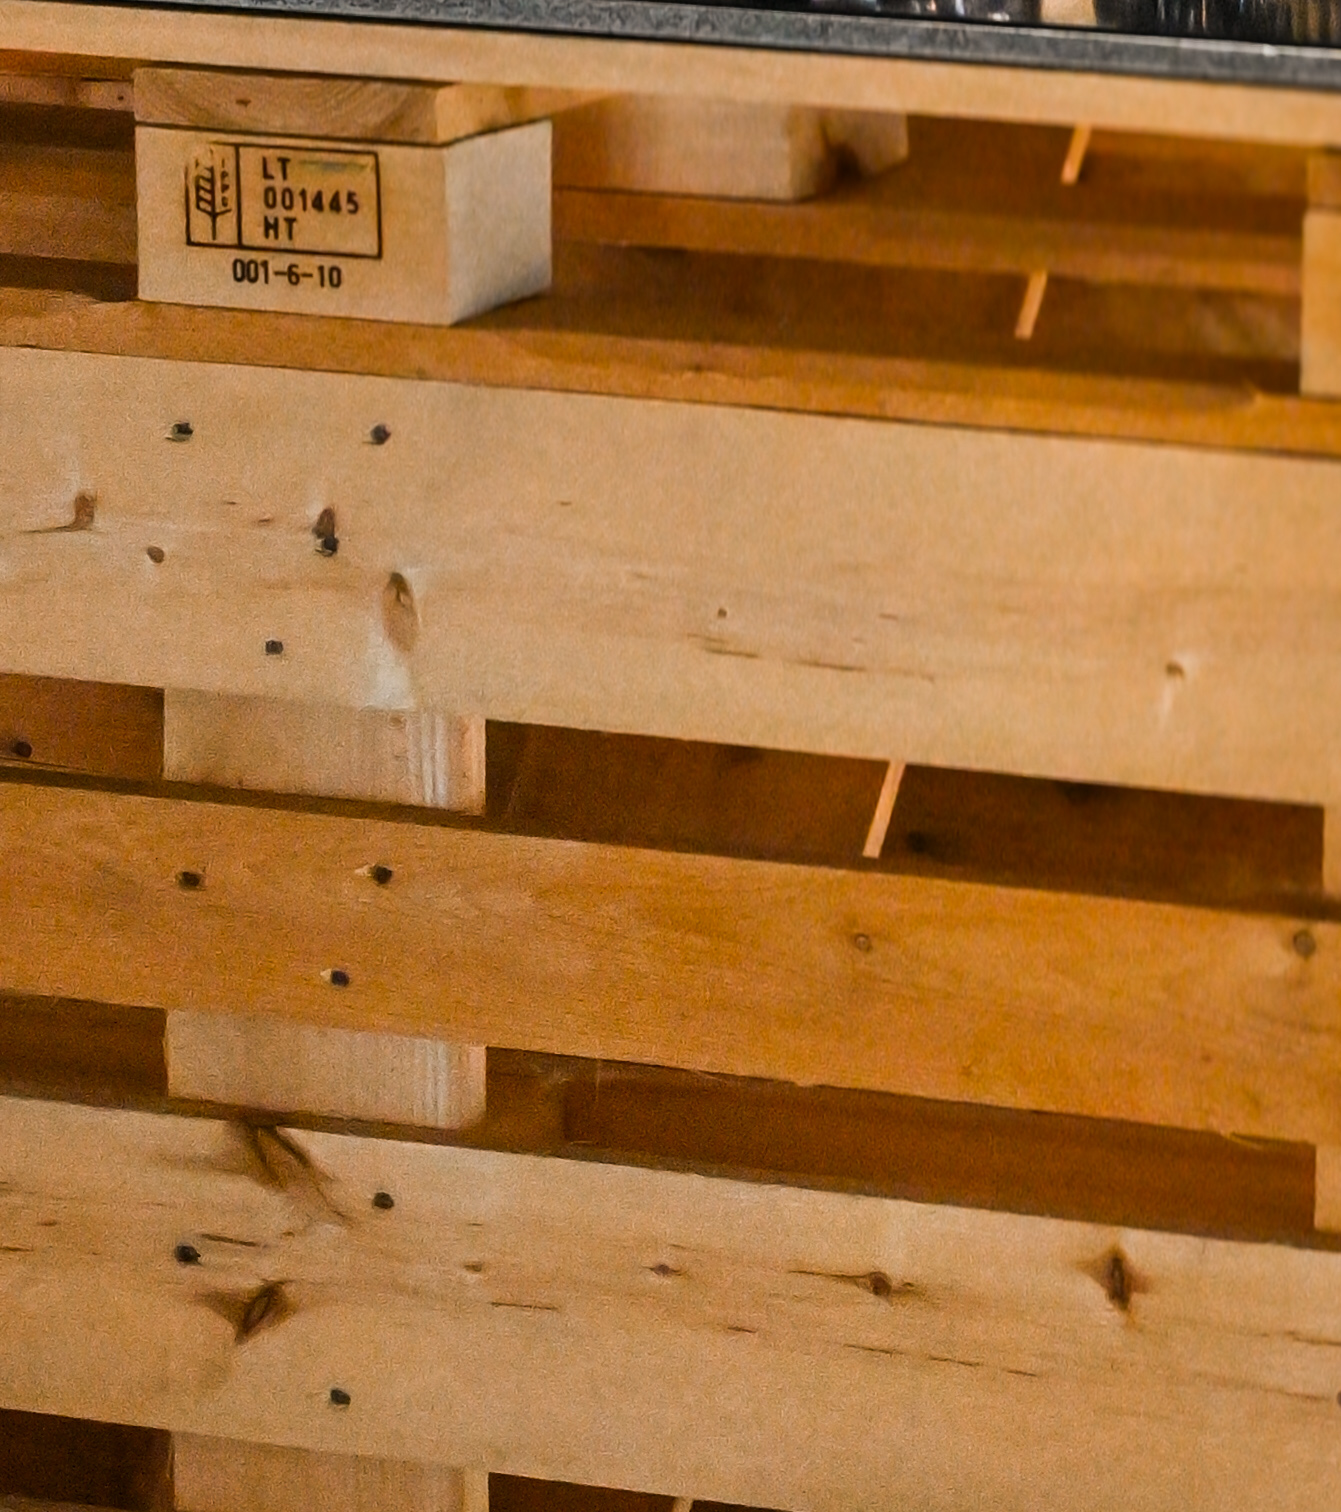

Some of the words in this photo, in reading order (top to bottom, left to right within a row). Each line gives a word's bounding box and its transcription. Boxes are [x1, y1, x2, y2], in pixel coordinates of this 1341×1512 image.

[261, 156, 292, 181] LT
[263, 186, 360, 215] 001445
[263, 215, 298, 241] HT
[232, 258, 342, 289] 001-6-10
